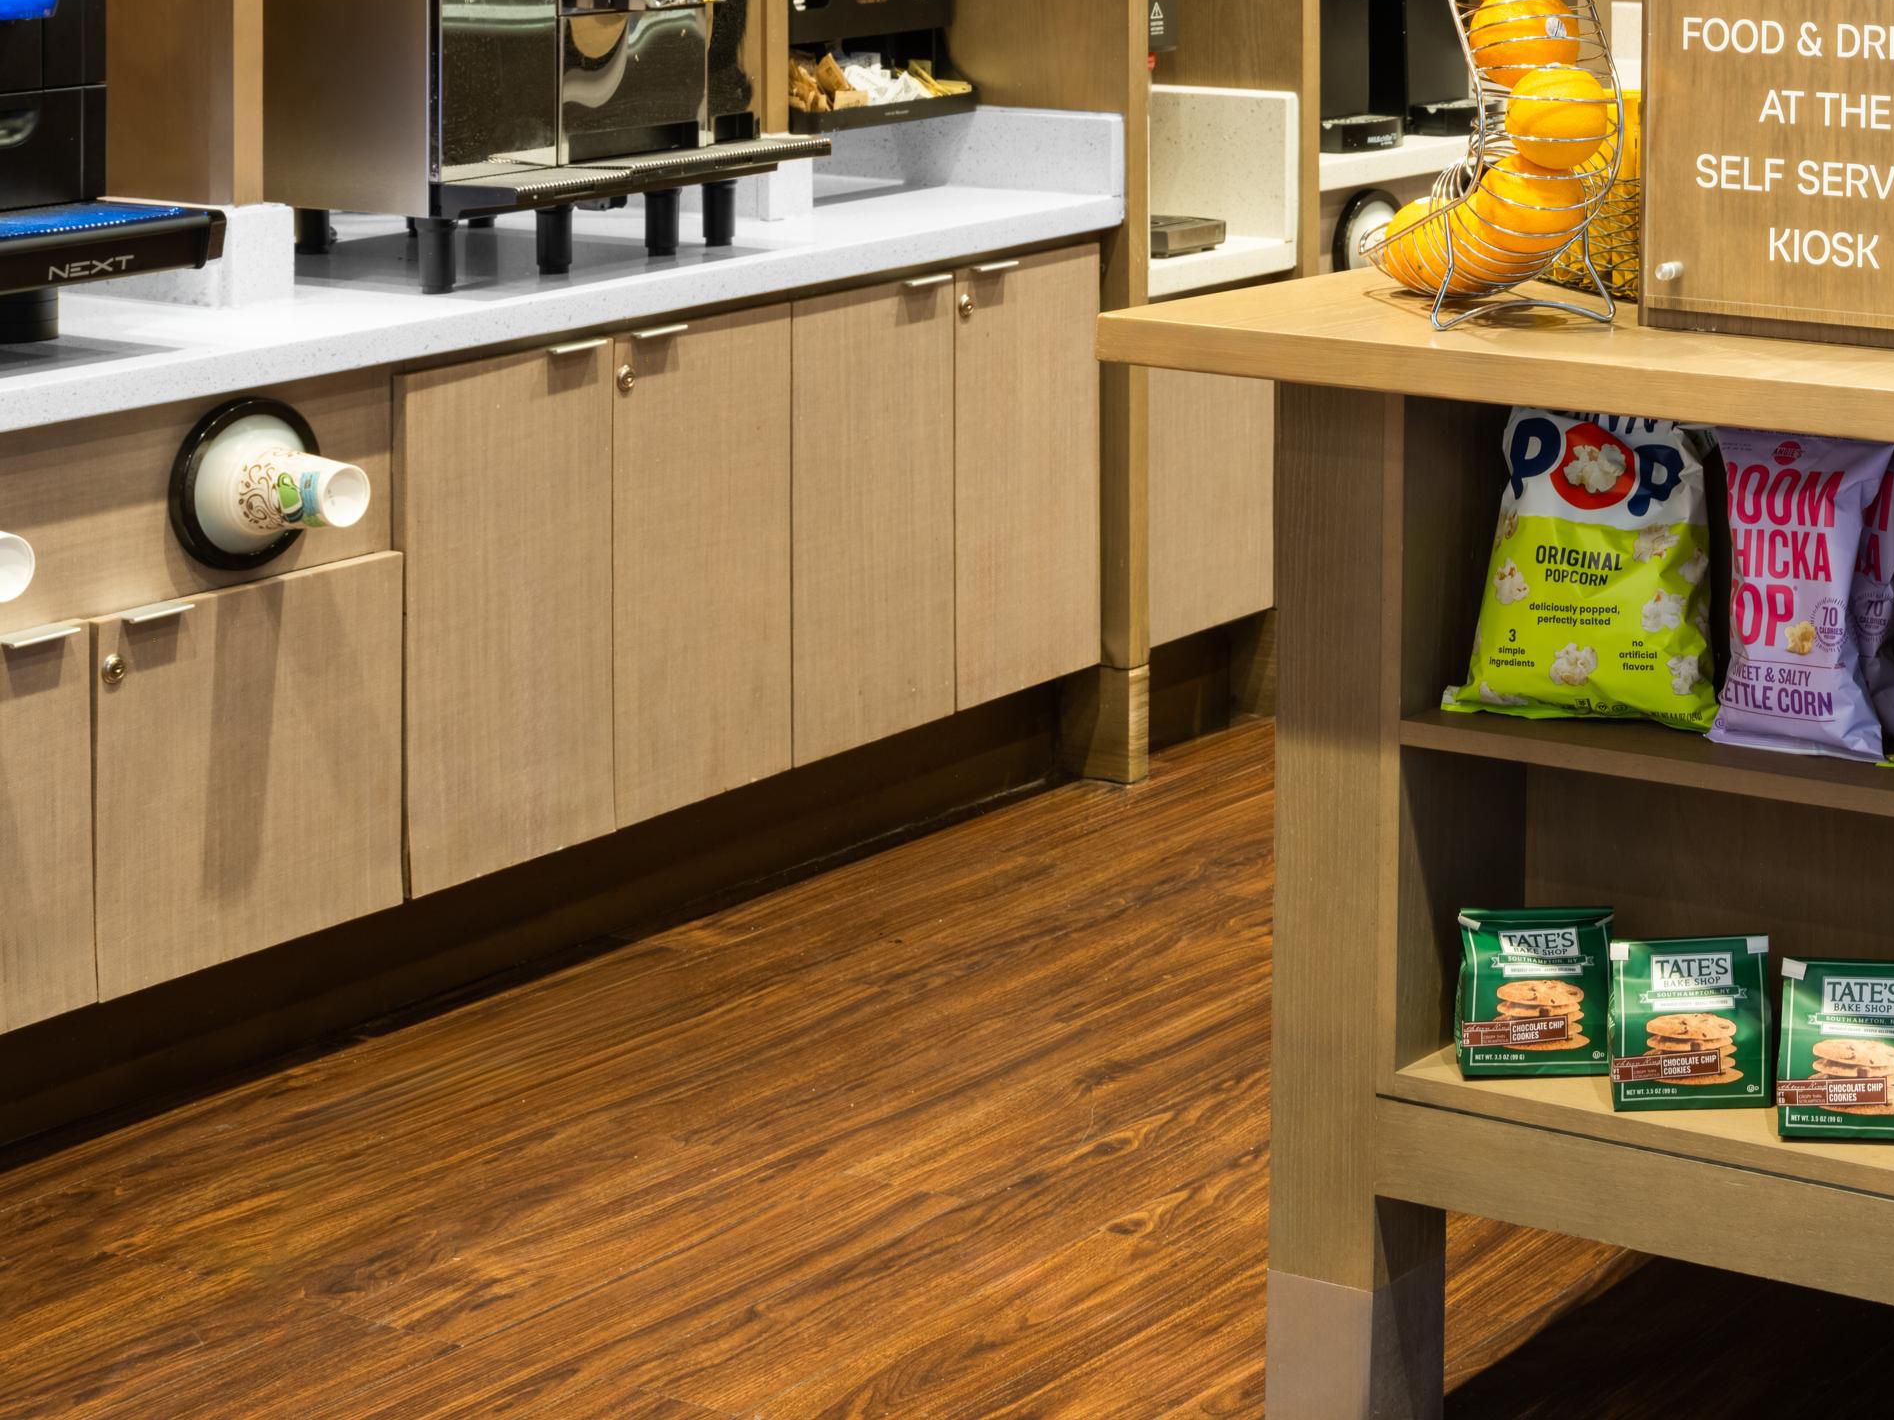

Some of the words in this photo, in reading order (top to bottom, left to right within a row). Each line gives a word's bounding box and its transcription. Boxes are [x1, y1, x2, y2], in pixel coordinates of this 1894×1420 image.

[1682, 17, 1784, 55] FOOD
[1797, 21, 1822, 57] &
[1758, 89, 1804, 124] AT
[1816, 92, 1892, 131] THE
[1695, 153, 1784, 192] SELF
[1768, 227, 1880, 269] KIOSK
[48, 253, 134, 283] NEXT
[1535, 544, 1623, 571] ORIGINAL
[1545, 568, 1609, 587] POPCORN
[1529, 602, 1577, 615] deliciously
[1579, 604, 1620, 617] popped,
[1866, 599, 1884, 617] 70
[1537, 614, 1577, 627] perfectly
[1580, 616, 1611, 626] salted
[1823, 606, 1838, 627] 70
[1508, 629, 1516, 643] 3
[1819, 627, 1844, 636] CALORIES
[1632, 640, 1644, 648] no
[1498, 646, 1526, 656] simple
[1619, 651, 1658, 660] artificial
[1489, 657, 1535, 669] ingredients
[1622, 662, 1655, 672] flavors
[1765, 666, 1776, 683] &
[1778, 668, 1811, 687] SALTY
[1778, 687, 1834, 716] CORN
[1502, 931, 1574, 949] TATE'S
[1513, 947, 1540, 955] BAKE
[1542, 948, 1568, 956] SHOP
[1655, 958, 1728, 978] TATE'S
[1663, 979, 1690, 988] BAKE
[1694, 976, 1720, 986] SHOP
[1834, 1003, 1861, 1012] BAKE
[1865, 1004, 1892, 1013] SHOP
[1512, 1023, 1547, 1033] CHOCOLATE
[1549, 1020, 1565, 1030] CHIP
[1512, 1032, 1540, 1041] COOKIES
[1663, 1057, 1699, 1067] CHOCOLATE
[1700, 1055, 1717, 1064] CHIP
[1663, 1066, 1691, 1075] COOKIES
[1626, 1088, 1636, 1096] NET
[1828, 1084, 1866, 1093] CHOCOLATE
[1867, 1083, 1883, 1092] CHIP
[1829, 1093, 1857, 1102] COOKIES
